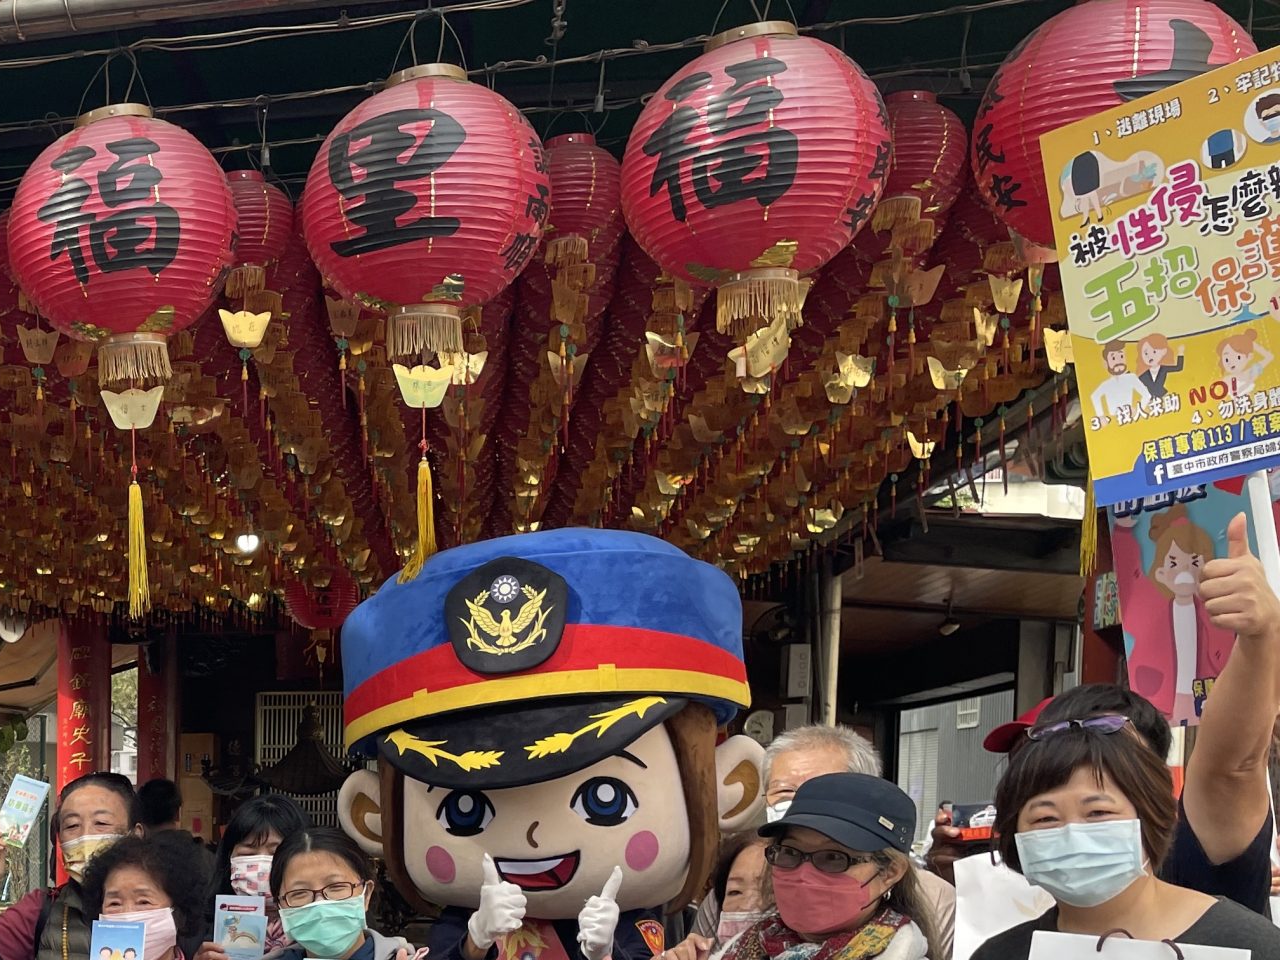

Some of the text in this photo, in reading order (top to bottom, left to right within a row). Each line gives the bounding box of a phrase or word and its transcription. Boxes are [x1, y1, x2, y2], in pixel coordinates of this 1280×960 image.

[38, 137, 181, 284] 福
[328, 108, 467, 257] 里
[643, 58, 799, 224] 福
[1189, 377, 1238, 406] NO!
